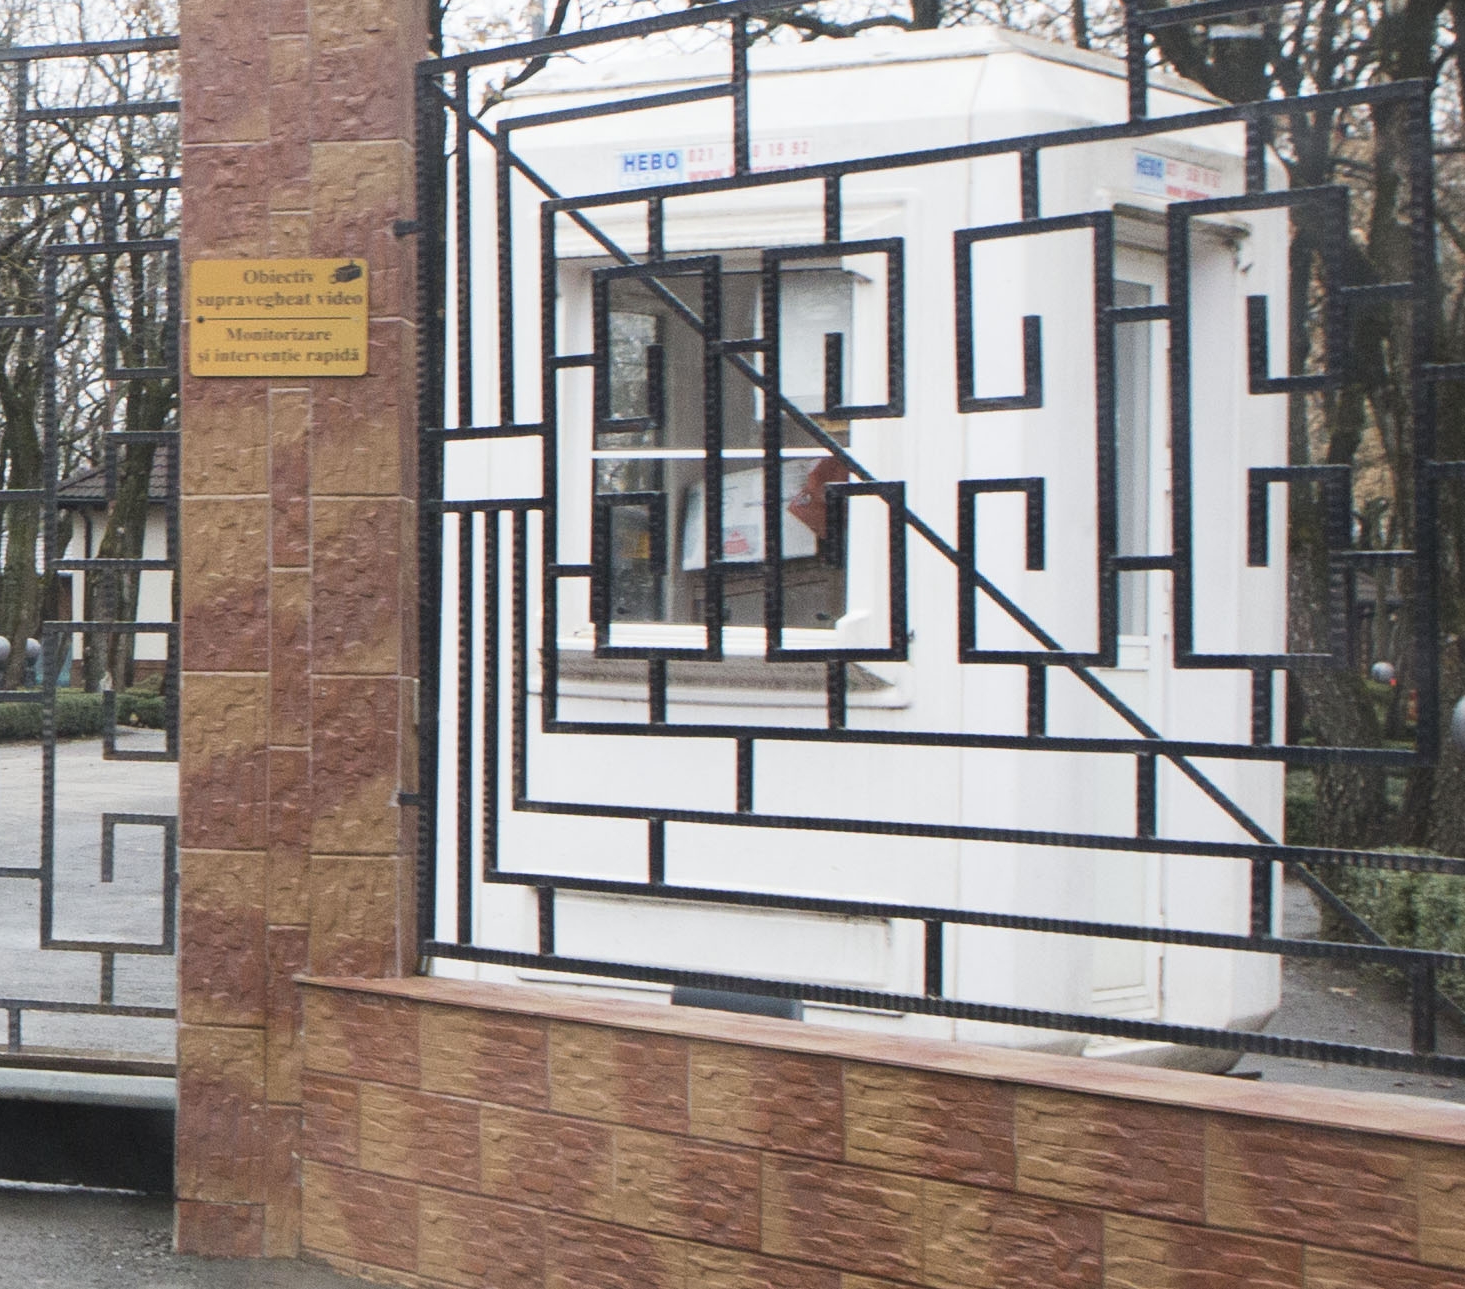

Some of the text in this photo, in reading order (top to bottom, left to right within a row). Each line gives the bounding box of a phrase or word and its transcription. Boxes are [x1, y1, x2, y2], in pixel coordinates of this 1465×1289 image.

[623, 152, 679, 172] HEBO
[243, 269, 314, 285] Obiectiv
[196, 290, 363, 310] supravegheat video
[225, 327, 332, 342] Monitorizare
